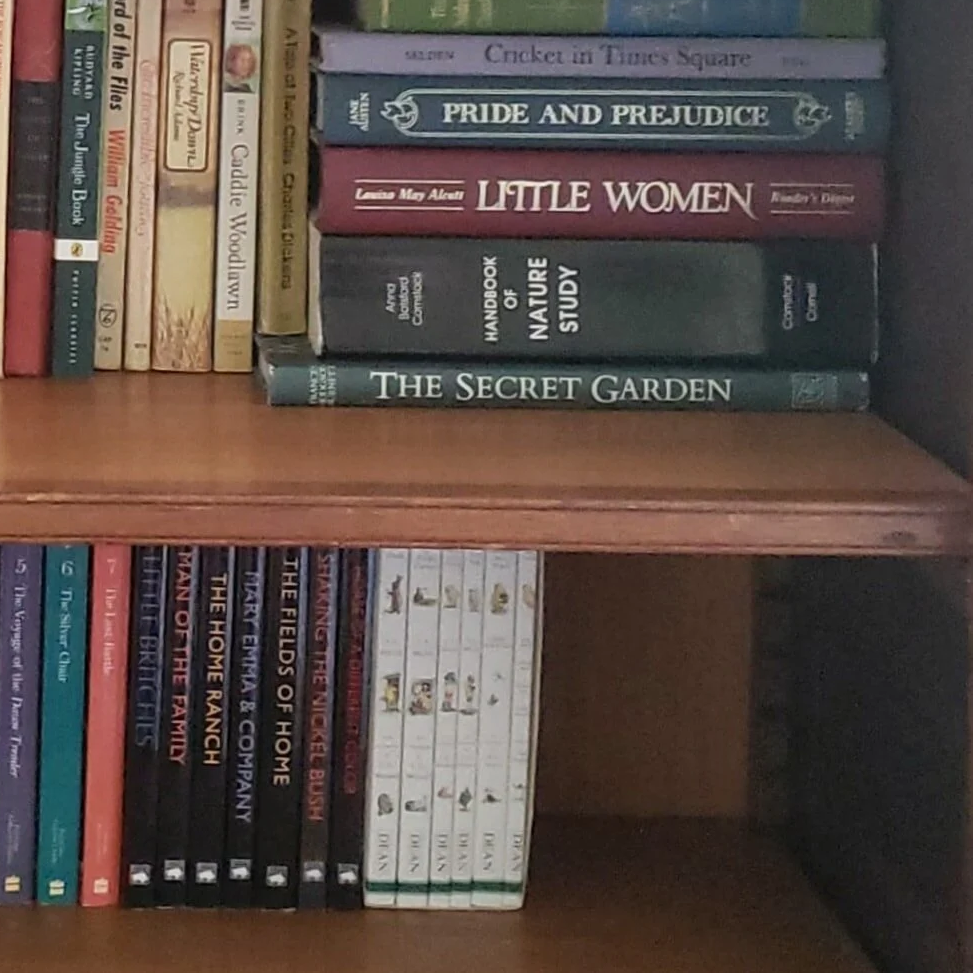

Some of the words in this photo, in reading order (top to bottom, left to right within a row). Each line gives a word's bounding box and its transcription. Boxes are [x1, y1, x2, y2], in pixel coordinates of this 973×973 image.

[113, 24, 131, 38] of
[72, 49, 82, 96] KIPLING
[84, 45, 95, 100] RUDYARD
[111, 46, 128, 69] the
[110, 76, 128, 111] Flies
[349, 99, 360, 125] JANE
[360, 92, 370, 130] AUSTEN
[443, 103, 529, 124] PRIDE
[538, 104, 602, 125] AND
[611, 105, 769, 127] PREJUDICE
[75, 114, 90, 138] The
[72, 141, 89, 185] Jungle
[107, 130, 125, 187] William
[229, 145, 248, 207] Caddie
[72, 190, 88, 225] Book
[475, 180, 591, 212] LITTLE
[603, 182, 759, 221] WOMEN
[102, 195, 122, 254] Golding
[226, 213, 247, 310] Woodlawn
[385, 283, 396, 313] Anna
[398, 277, 409, 320] Botsford
[412, 271, 422, 326] Comstock
[483, 256, 498, 342] HANDBOOK
[504, 289, 518, 309] OF
[528, 257, 549, 340] NATURE
[559, 265, 579, 333] STUDY
[370, 371, 443, 400] THE
[456, 372, 581, 400] SECRET
[591, 375, 731, 403] GARDEN
[176, 552, 192, 601] MAN
[210, 574, 227, 612] THE
[284, 557, 298, 600] THE
[174, 611, 189, 639] OF
[278, 607, 296, 676] FIELDS
[172, 647, 188, 686] THE
[208, 620, 225, 682] HOME
[277, 684, 293, 713] OF
[170, 695, 186, 765] FAMILY
[203, 690, 222, 765] RANCH
[273, 721, 291, 786] HOME
